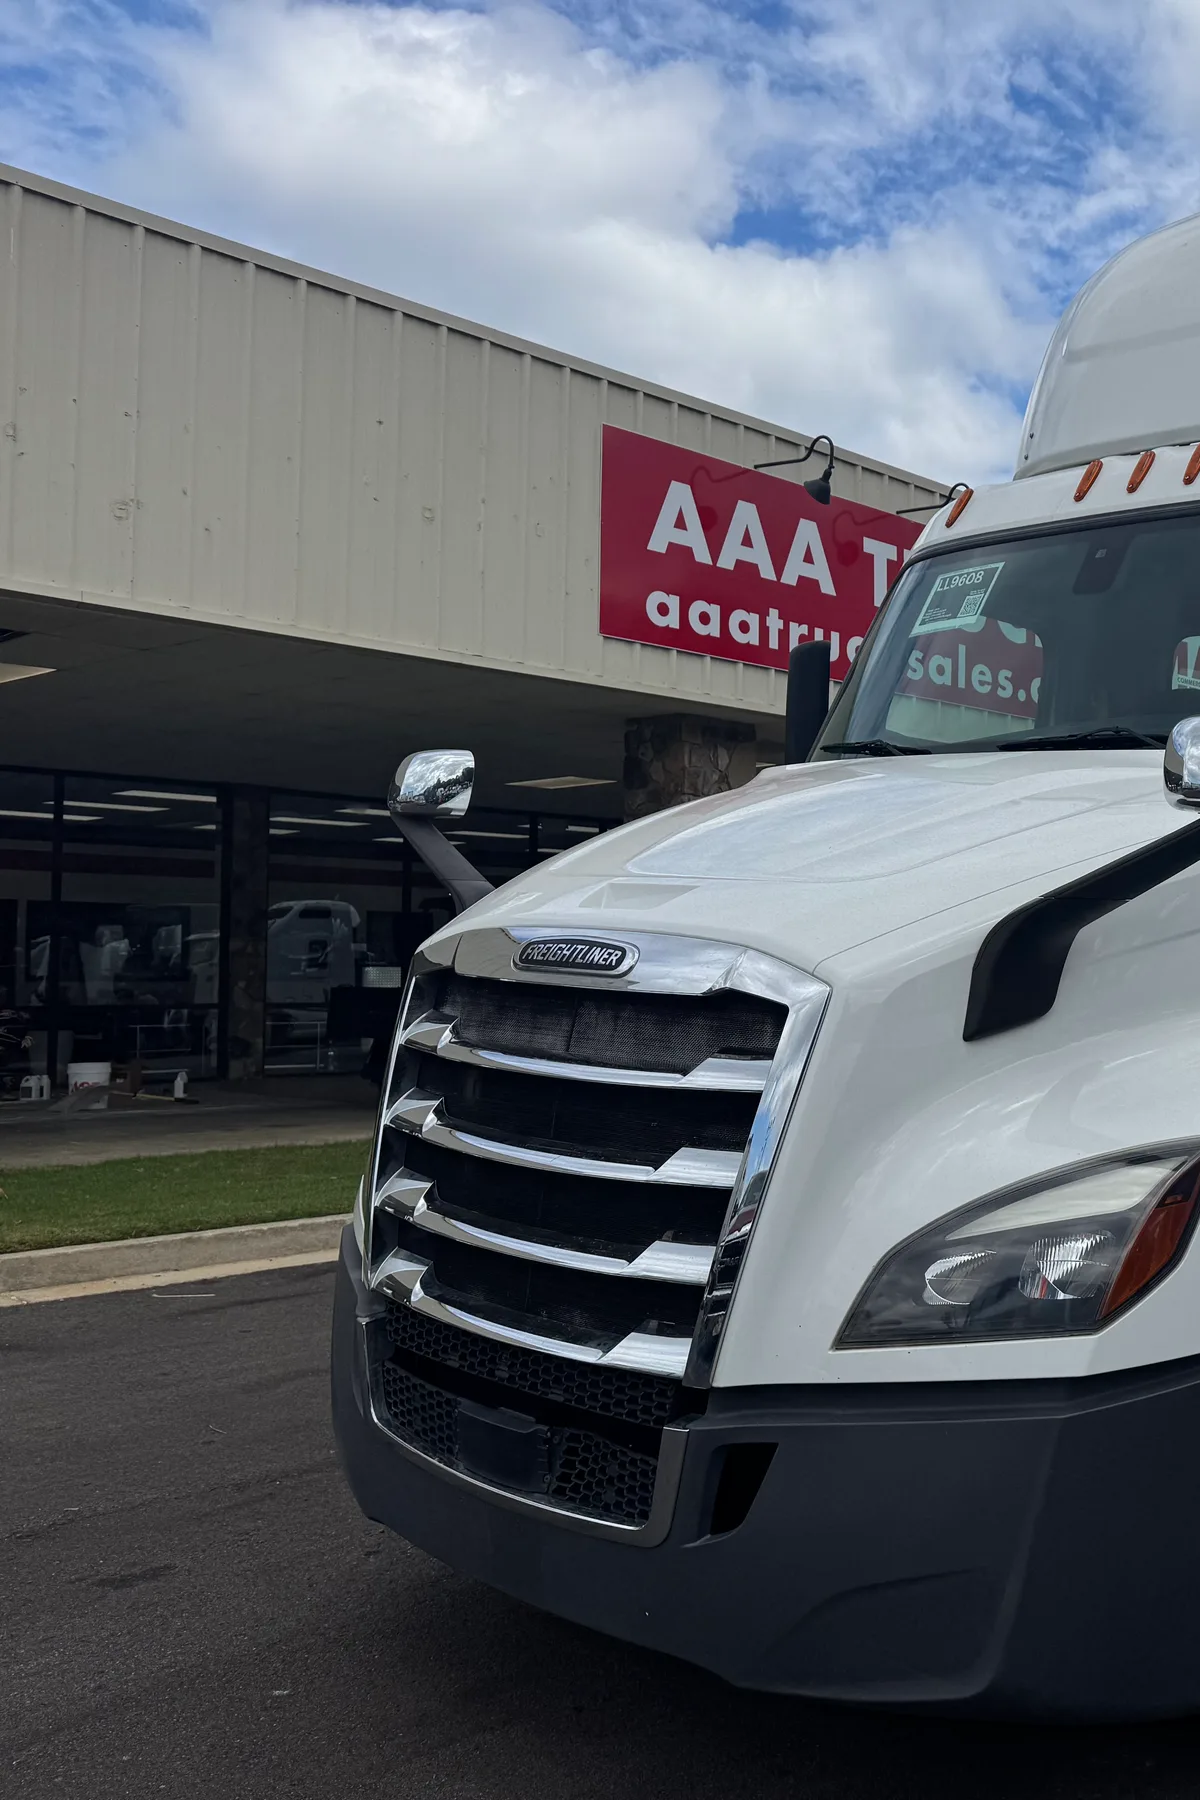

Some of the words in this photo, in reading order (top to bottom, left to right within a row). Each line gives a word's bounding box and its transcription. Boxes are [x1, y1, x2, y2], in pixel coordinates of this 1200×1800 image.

[646, 480, 837, 597] AAA
[937, 571, 985, 592] LL9608
[522, 943, 623, 966] FREIGHTLINER
